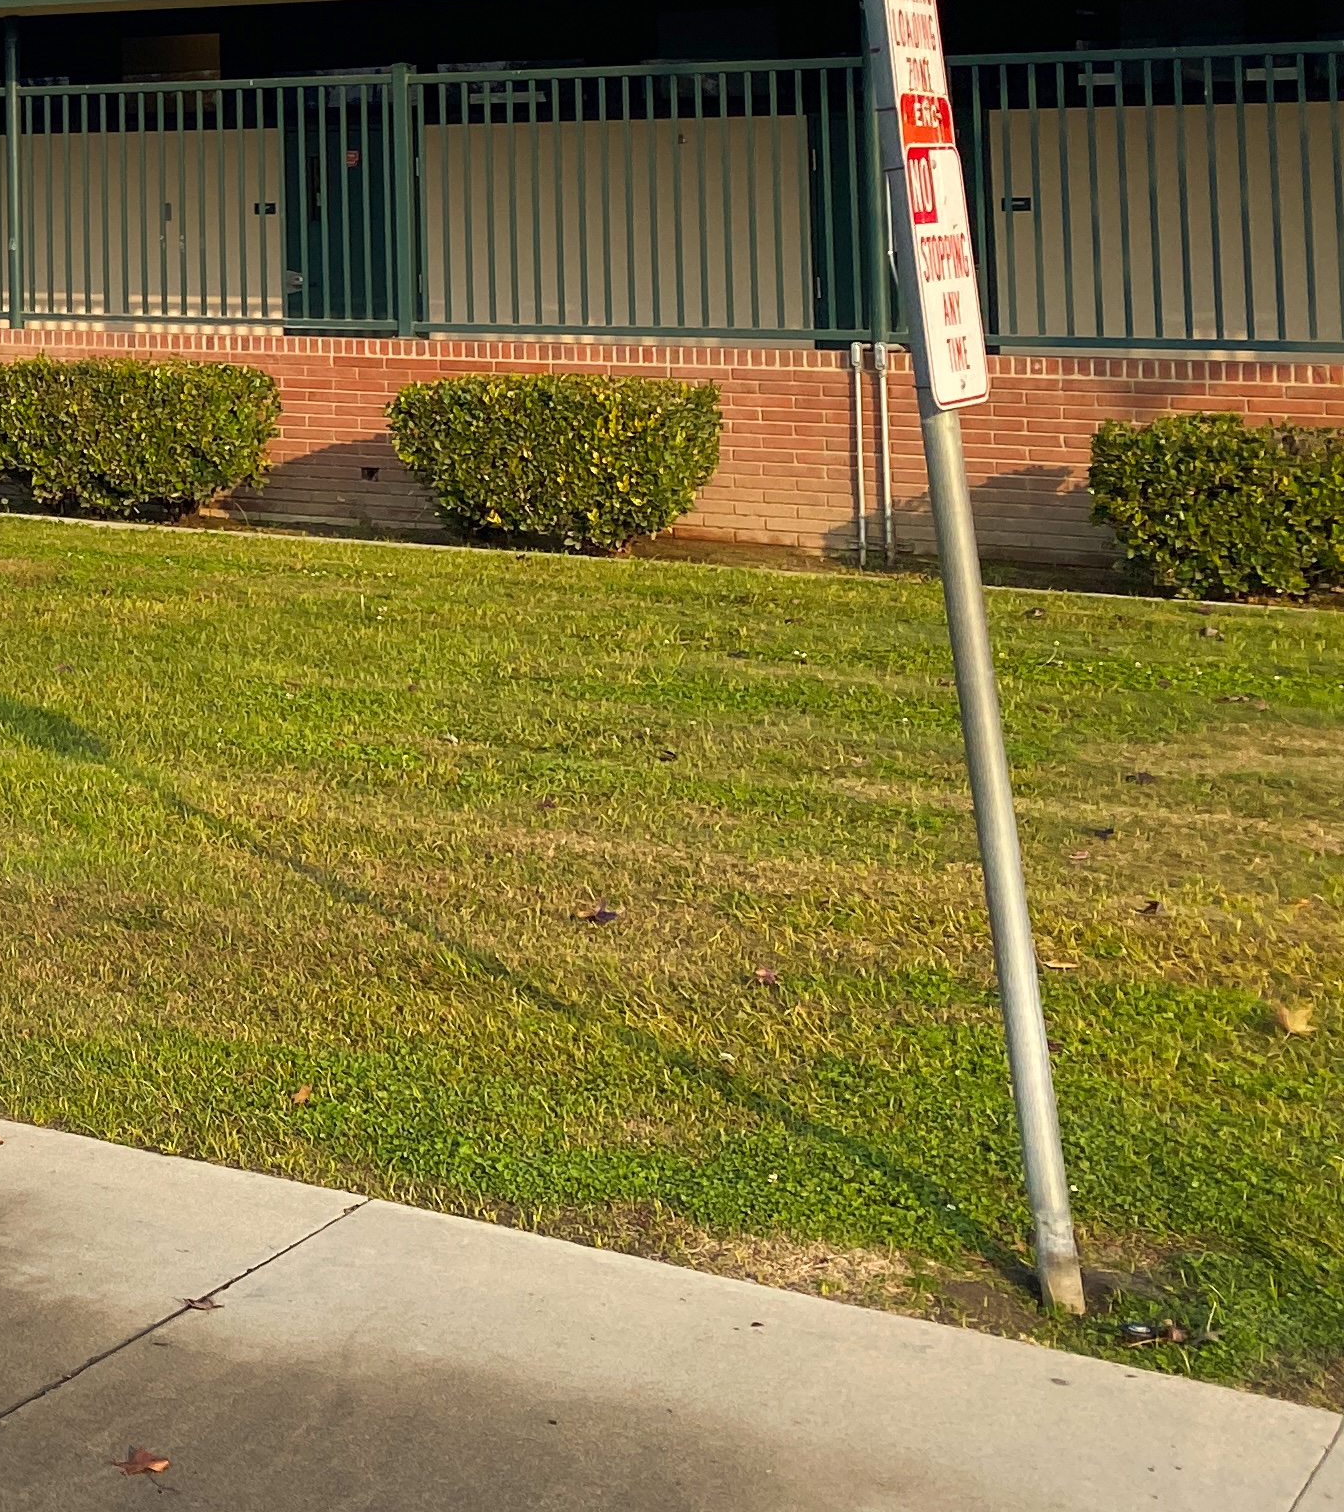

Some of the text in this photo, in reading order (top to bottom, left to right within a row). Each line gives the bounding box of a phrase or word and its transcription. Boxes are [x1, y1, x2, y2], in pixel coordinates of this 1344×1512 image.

[891, 7, 937, 52] LOADING
[906, 56, 932, 93] ZONE
[913, 99, 941, 129] END
[910, 157, 934, 214] NO
[920, 232, 970, 283] STOPPING
[942, 290, 962, 326] ANY
[946, 335, 971, 373] TIME
